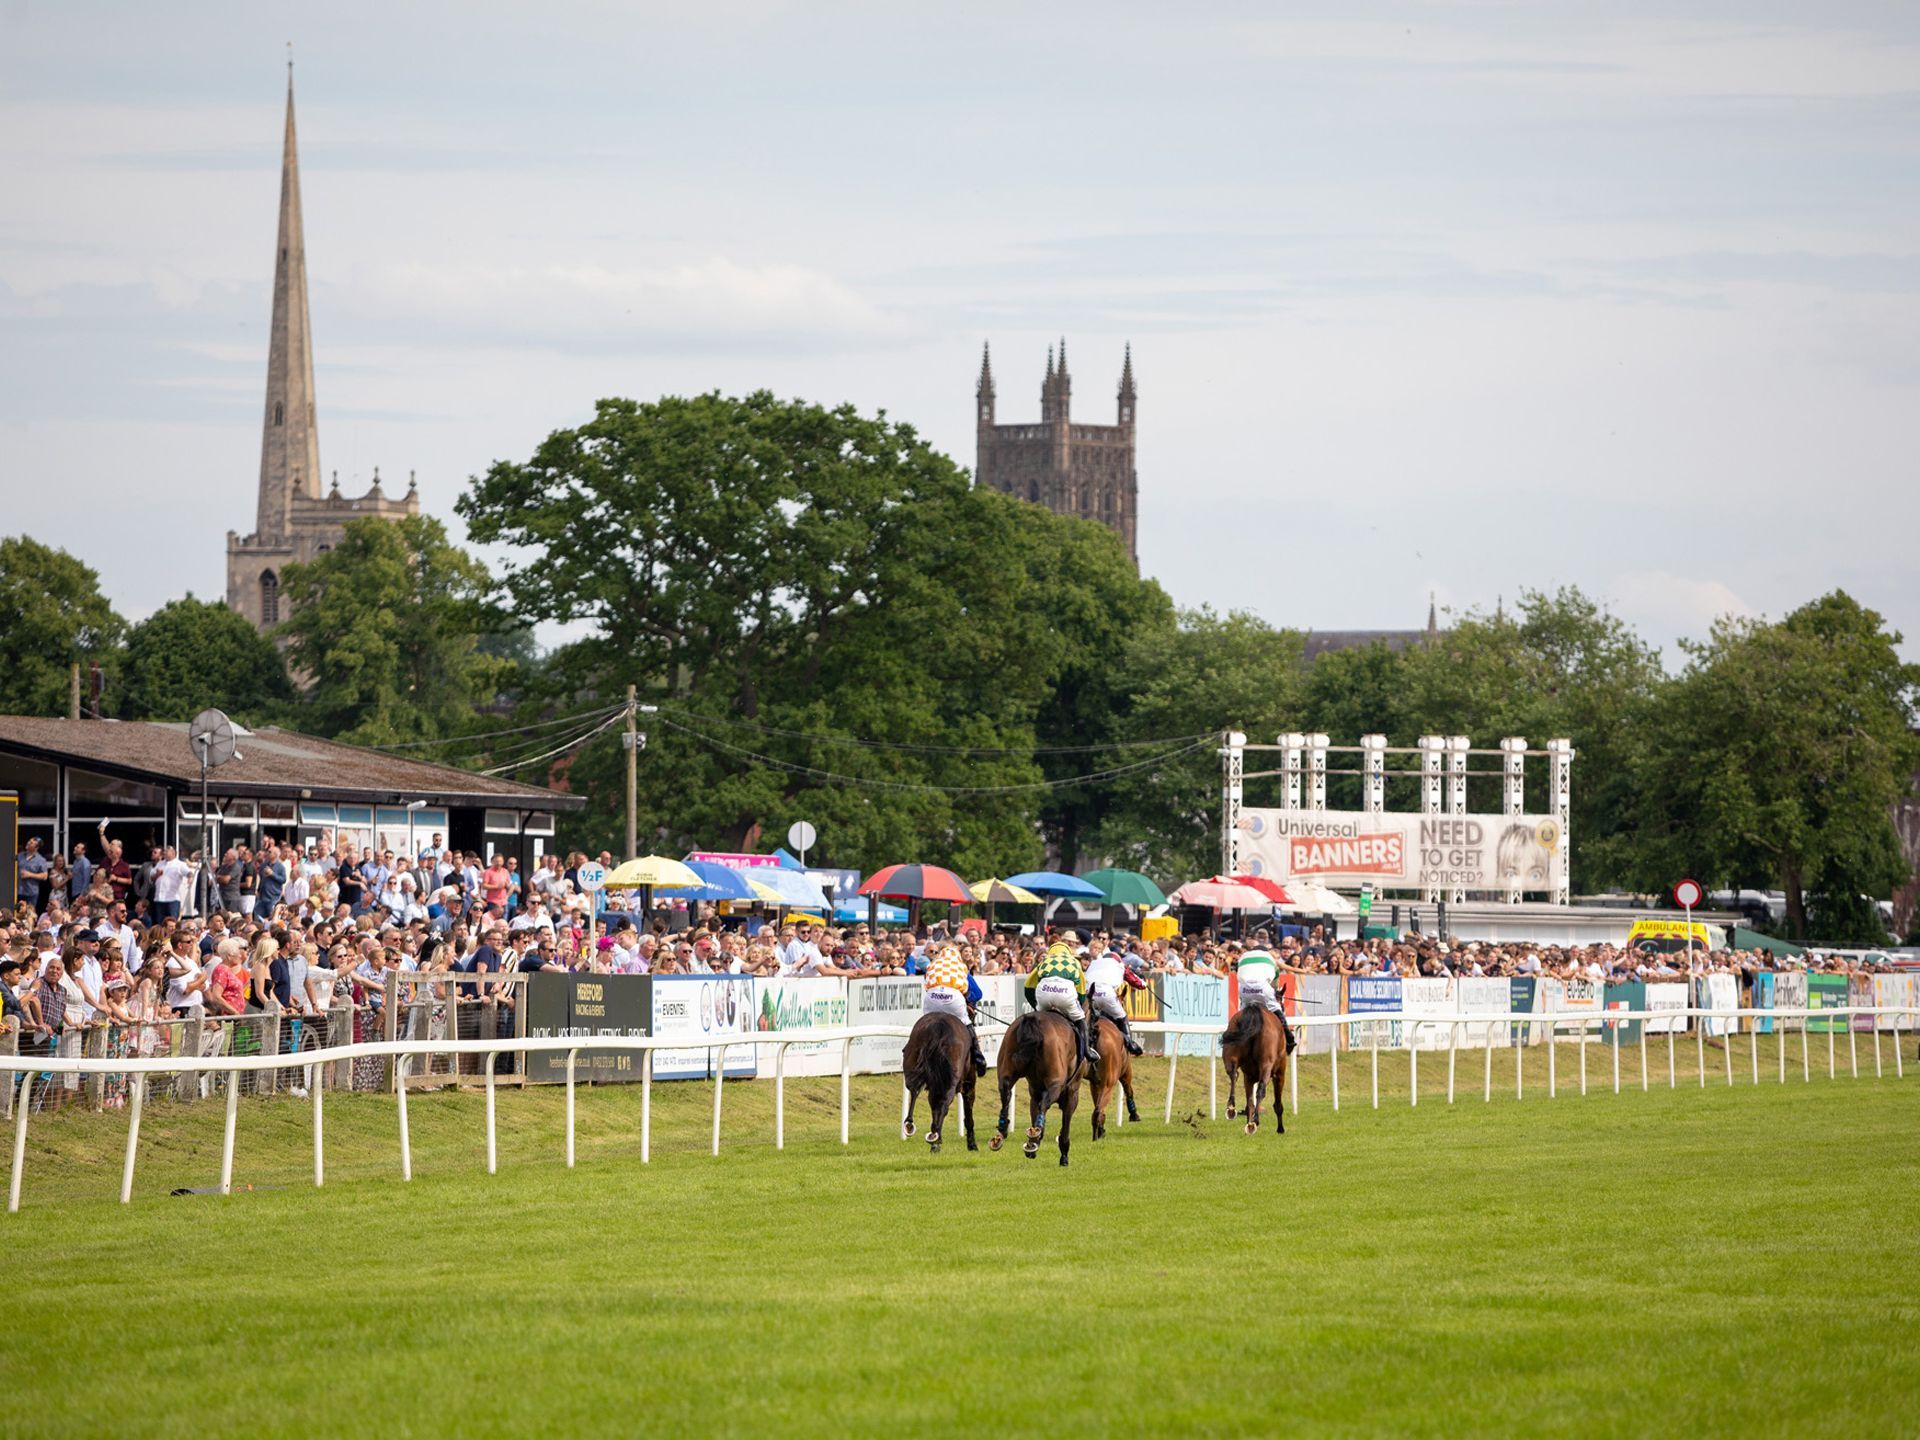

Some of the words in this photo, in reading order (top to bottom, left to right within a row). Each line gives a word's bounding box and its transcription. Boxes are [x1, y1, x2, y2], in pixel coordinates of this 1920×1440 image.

[1278, 818, 1357, 838] Universal
[1420, 820, 1483, 845] NEED
[1293, 838, 1401, 870] BANNERS
[1420, 849, 1443, 866] TO
[1448, 849, 1482, 867] GET
[1419, 870, 1483, 884] NOTICED?
[576, 983, 604, 1002] HEREFORD
[930, 992, 953, 1000] Stobart
[1041, 984, 1068, 994] Stobart
